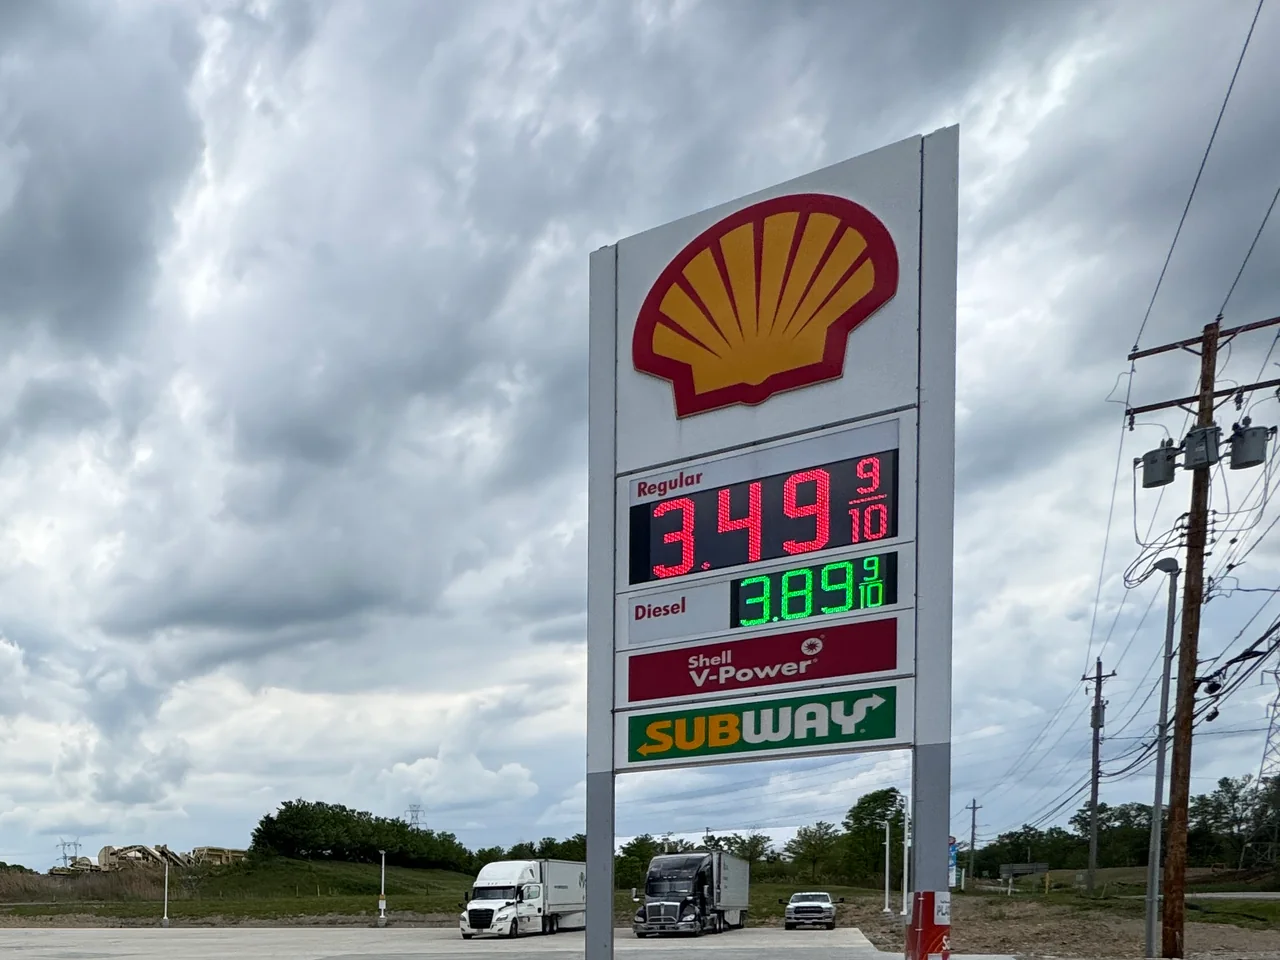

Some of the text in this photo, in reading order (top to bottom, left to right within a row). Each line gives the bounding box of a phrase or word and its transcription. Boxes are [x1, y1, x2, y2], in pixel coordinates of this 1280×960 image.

[637, 471, 703, 498] Regular
[856, 457, 880, 494] 9
[652, 469, 830, 578] 3.49
[848, 503, 888, 543] 10
[863, 556, 880, 581] 9
[740, 561, 854, 626] 3.89
[859, 582, 884, 609] 10
[634, 597, 686, 621] Diesel
[688, 650, 732, 668] Shell
[688, 660, 812, 688] V-Power
[636, 693, 887, 757] SUBWAY
